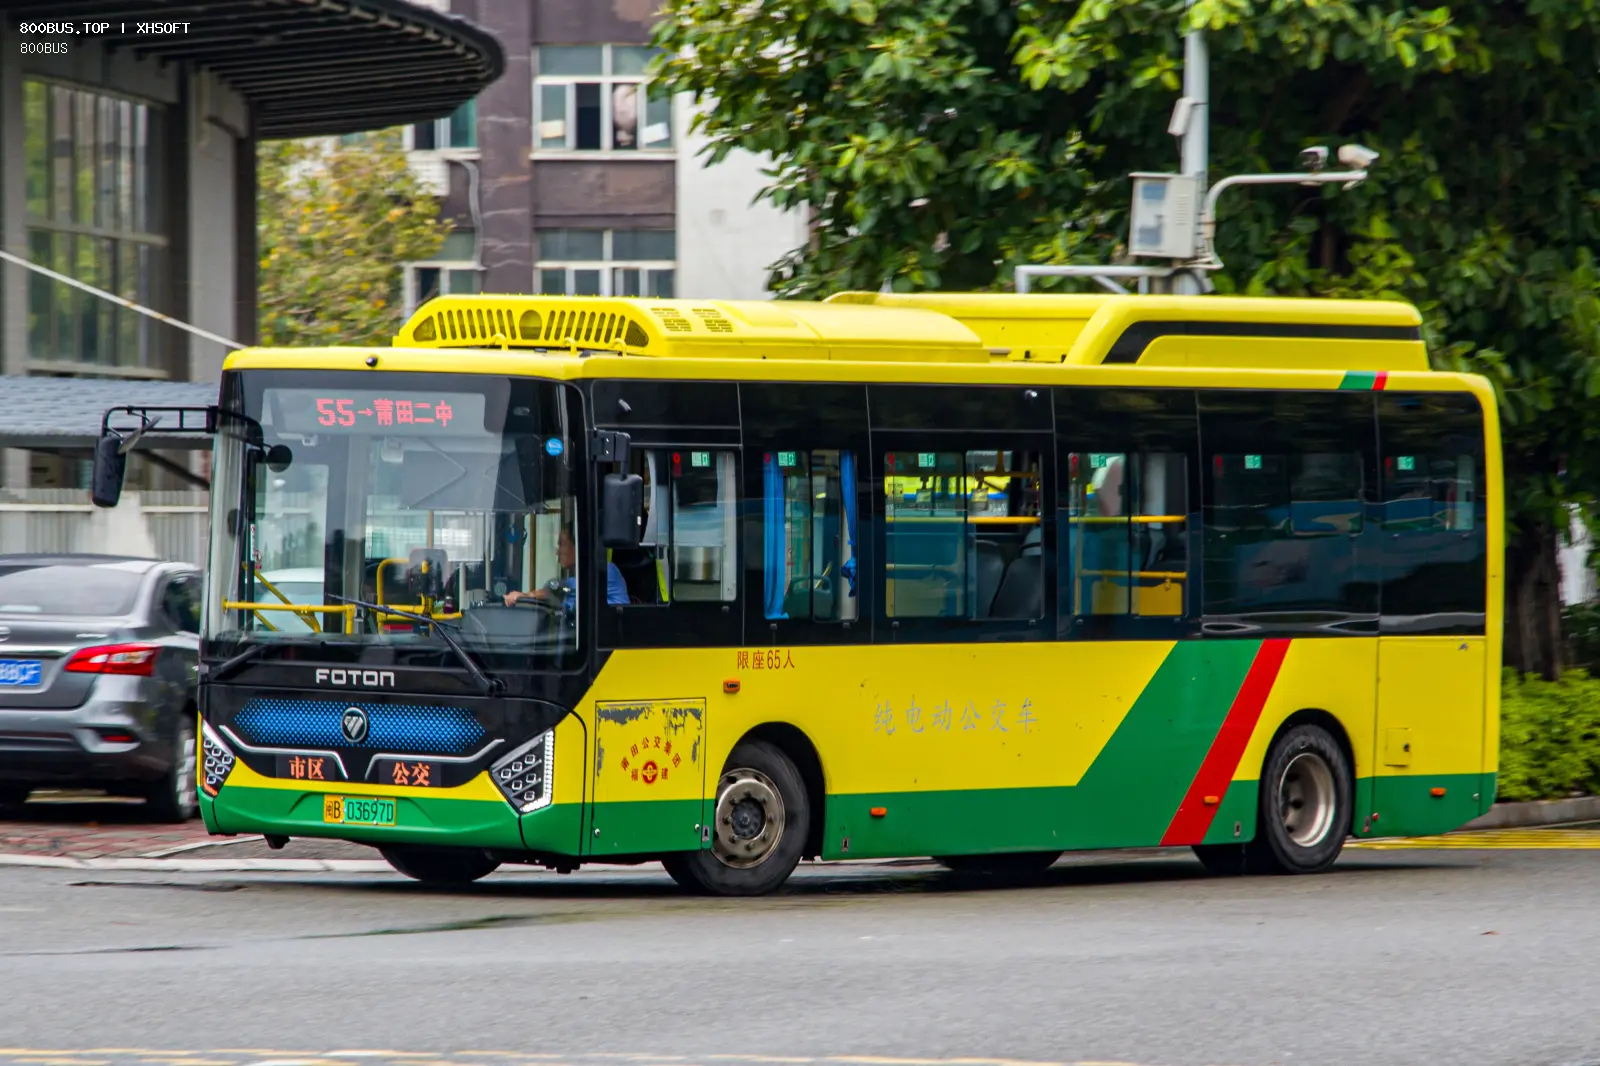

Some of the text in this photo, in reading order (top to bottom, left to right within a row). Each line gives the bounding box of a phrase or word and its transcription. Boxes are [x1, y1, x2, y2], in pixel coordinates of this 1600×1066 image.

[316, 398, 356, 427] 55
[737, 649, 795, 670] 限座65人
[315, 668, 395, 687] FOTON
[873, 697, 1038, 734] 纯电动公交车
[289, 755, 325, 780] 市区
[392, 761, 431, 787] 公交
